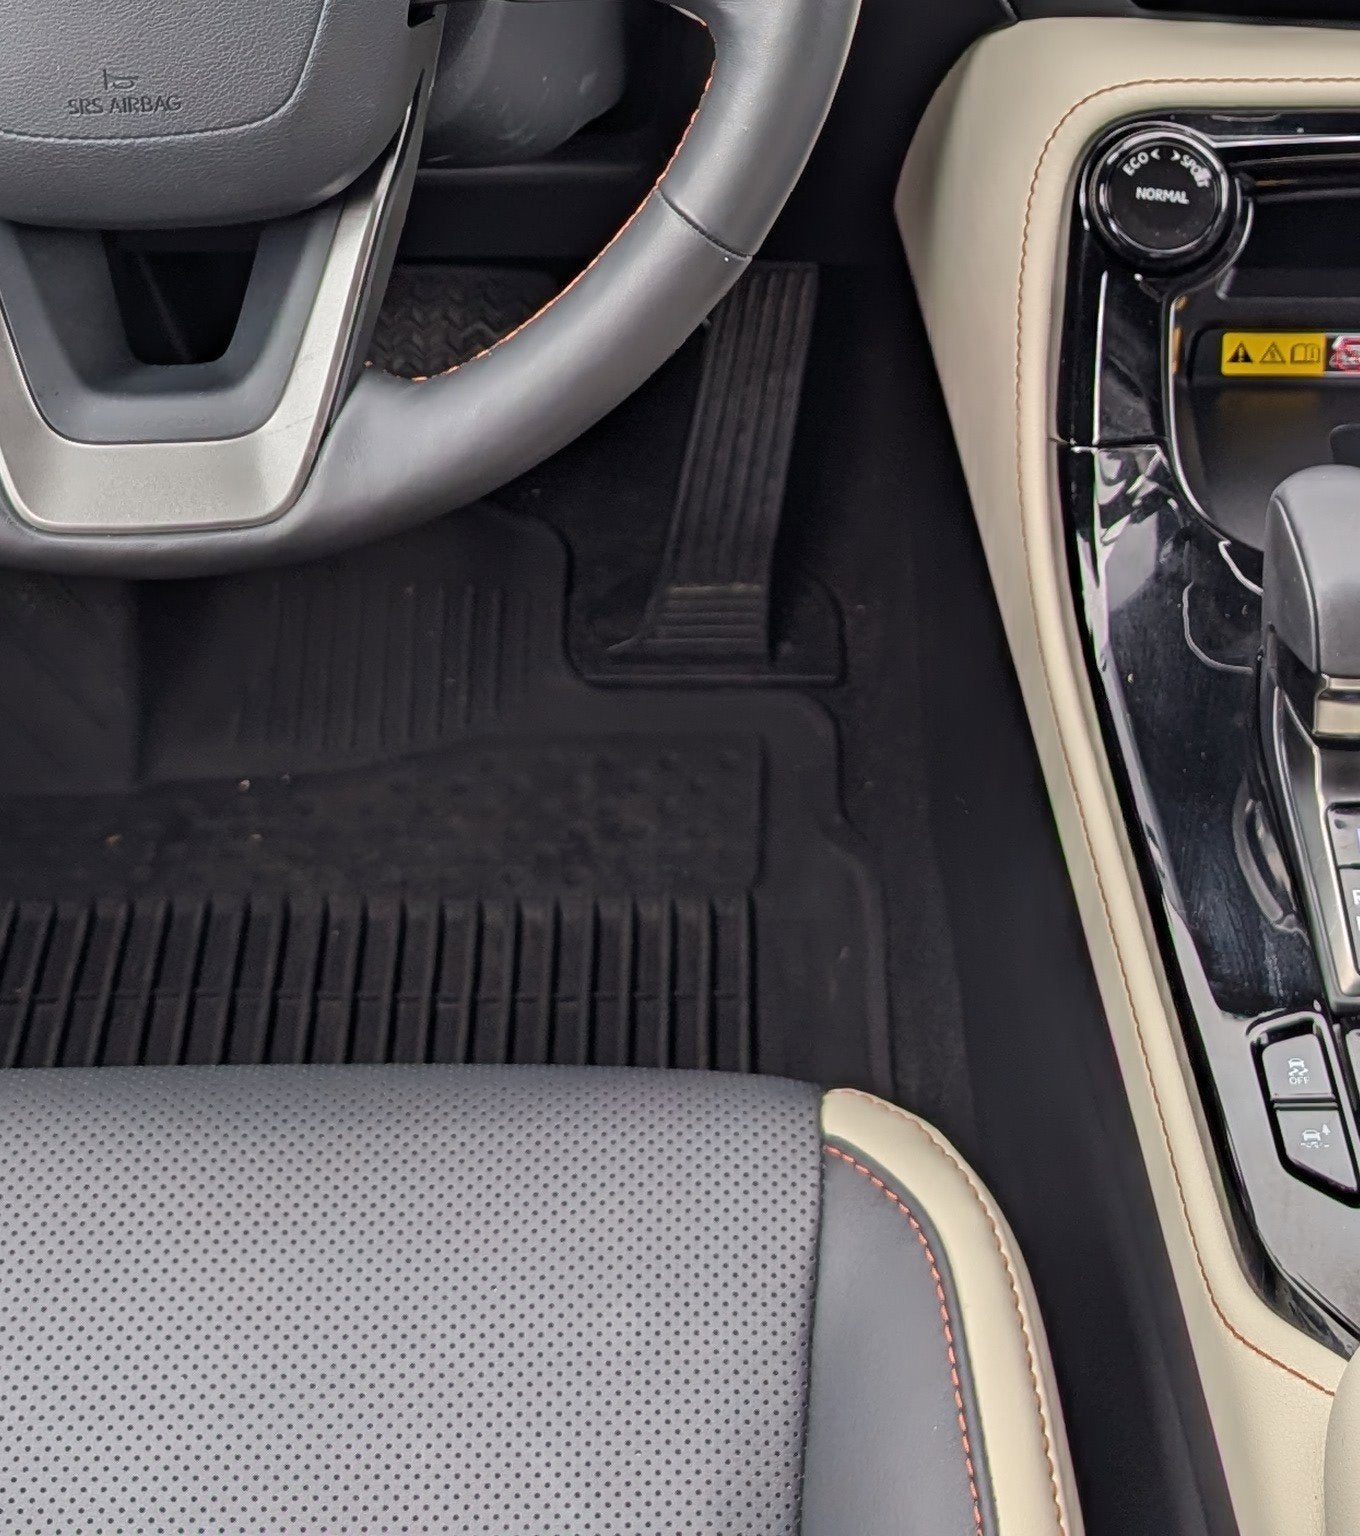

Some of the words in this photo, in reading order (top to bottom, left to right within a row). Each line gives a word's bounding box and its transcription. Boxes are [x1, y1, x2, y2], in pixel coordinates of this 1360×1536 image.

[68, 97, 104, 115] SRS
[109, 95, 183, 114] AIRBAG
[1122, 151, 1149, 177] ECO
[1180, 154, 1213, 188] SPORT
[1136, 186, 1189, 205] NORMAL
[1289, 1076, 1310, 1086] OFF
